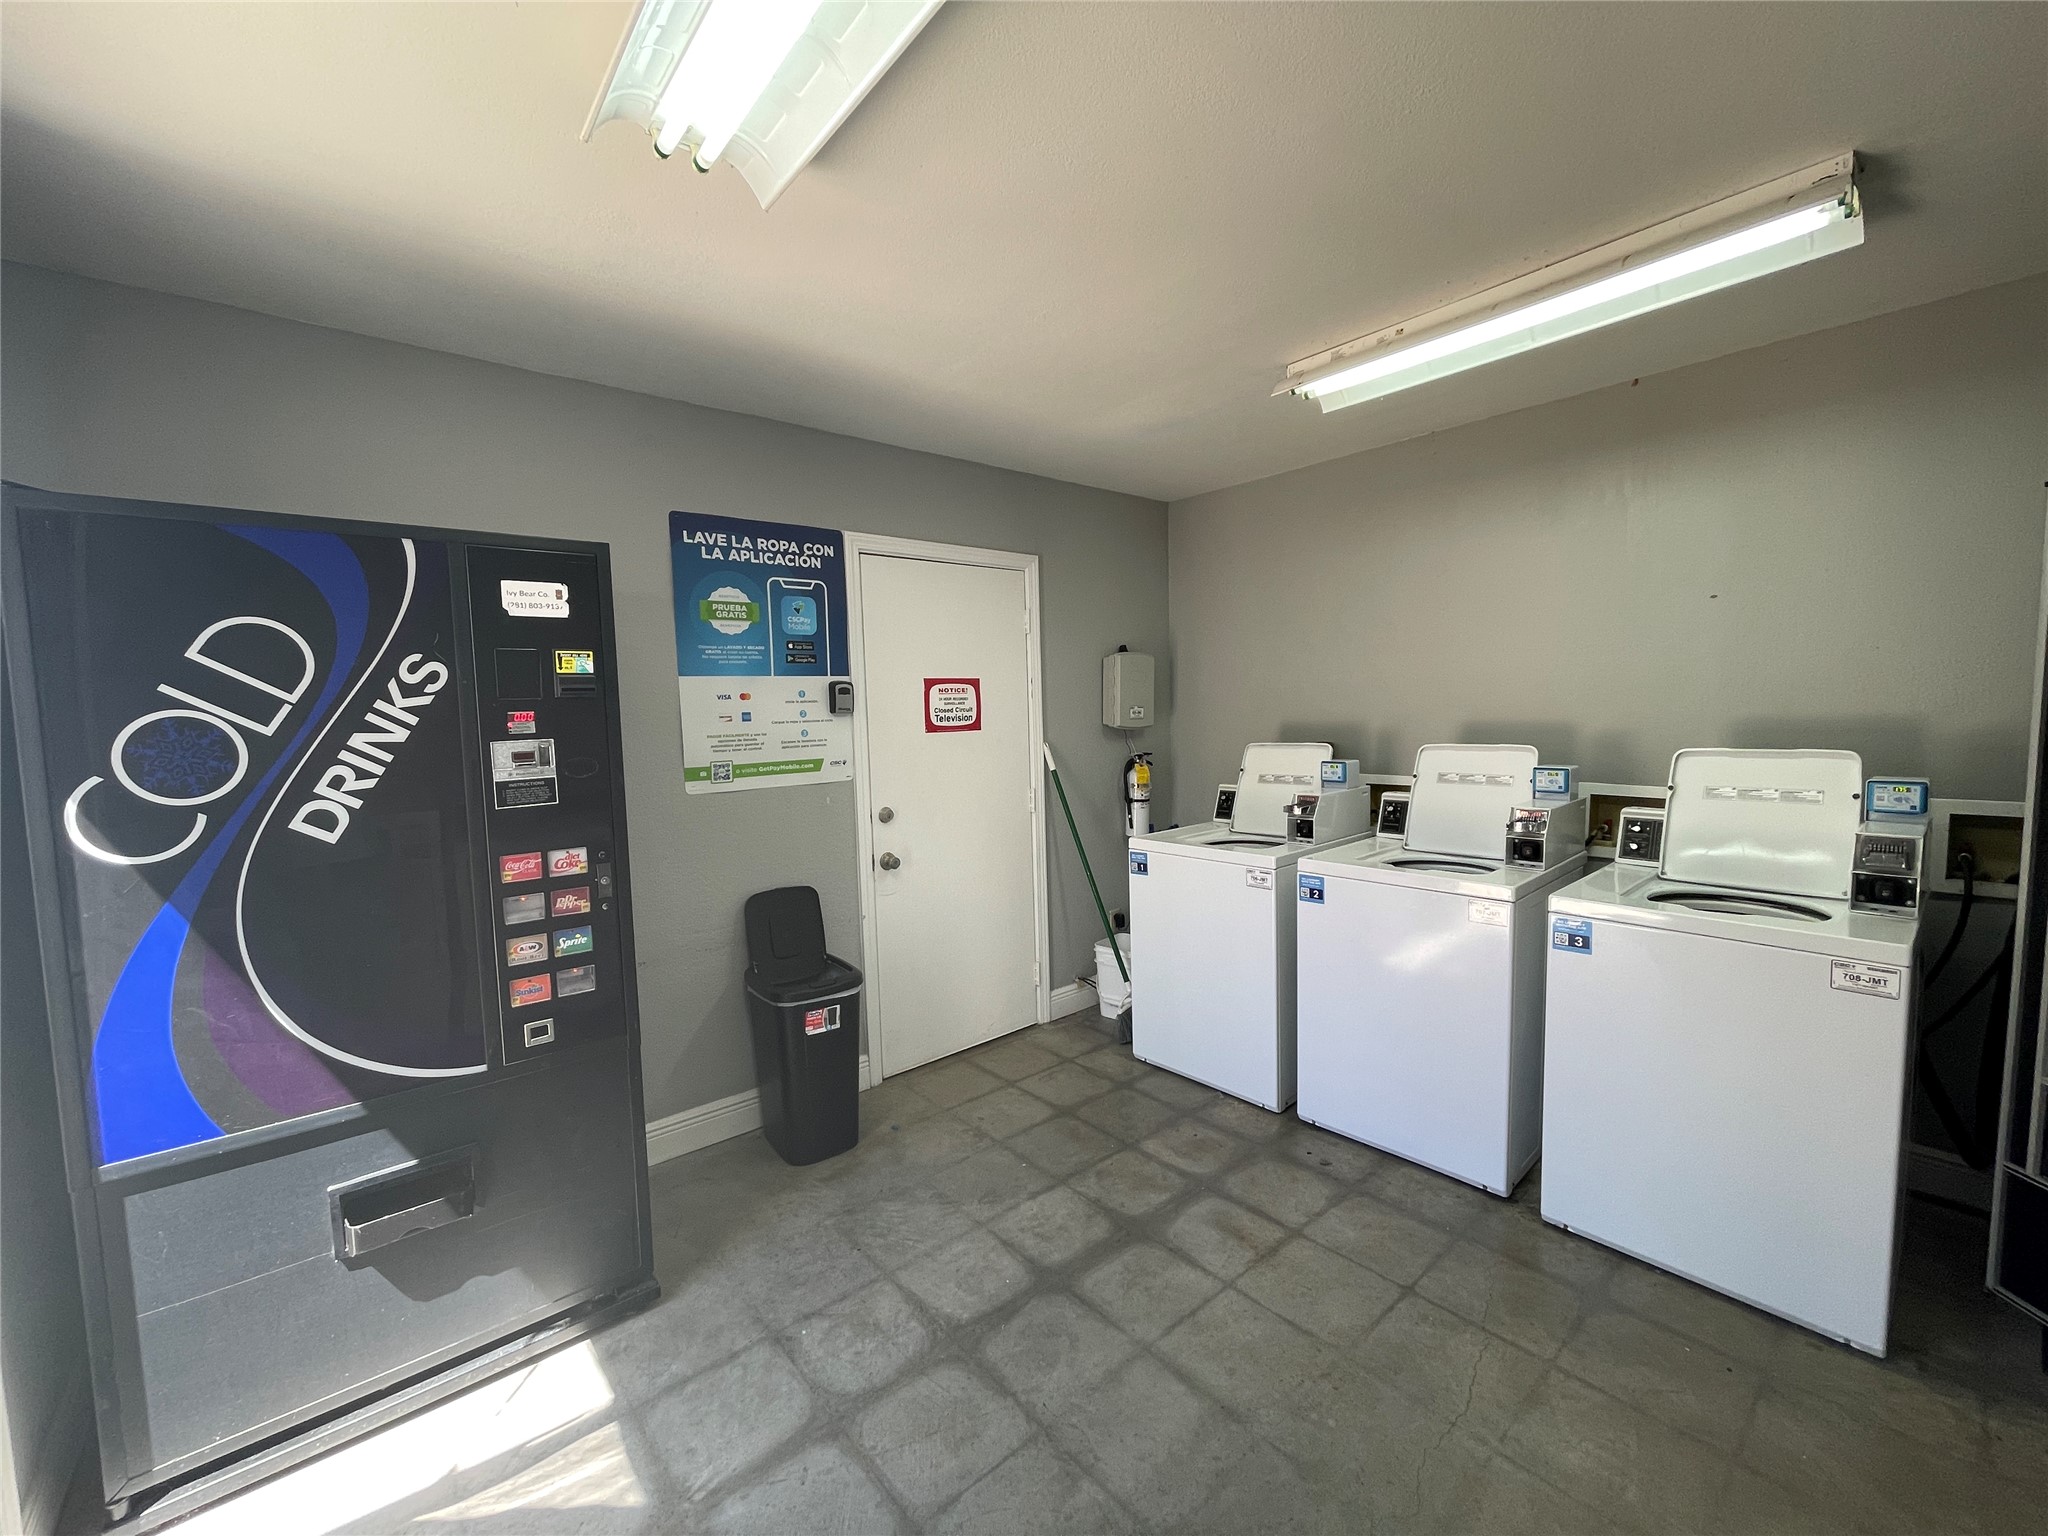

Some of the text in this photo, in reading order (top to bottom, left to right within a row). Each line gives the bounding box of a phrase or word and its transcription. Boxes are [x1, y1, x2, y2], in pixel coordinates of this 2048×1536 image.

[682, 530, 835, 557] LAVE LA ROPA CON
[701, 546, 822, 569] LA APLICACIÓN
[712, 603, 747, 612] PRUEBA
[716, 611, 747, 619] GRATIS
[935, 714, 973, 722] Television
[64, 616, 316, 865] COLD
[288, 653, 449, 845] DRINKS
[758, 763, 814, 772] GetPayMobile.com
[565, 851, 580, 860] diet
[554, 859, 581, 869] Coke
[1313, 890, 1319, 898] 2
[555, 898, 587, 909] Pepper
[557, 934, 588, 949] Sprite
[1574, 936, 1583, 947] 3
[519, 944, 537, 952] A&W
[1842, 973, 1889, 986] 708-JMT
[515, 986, 543, 996] Sunkist
